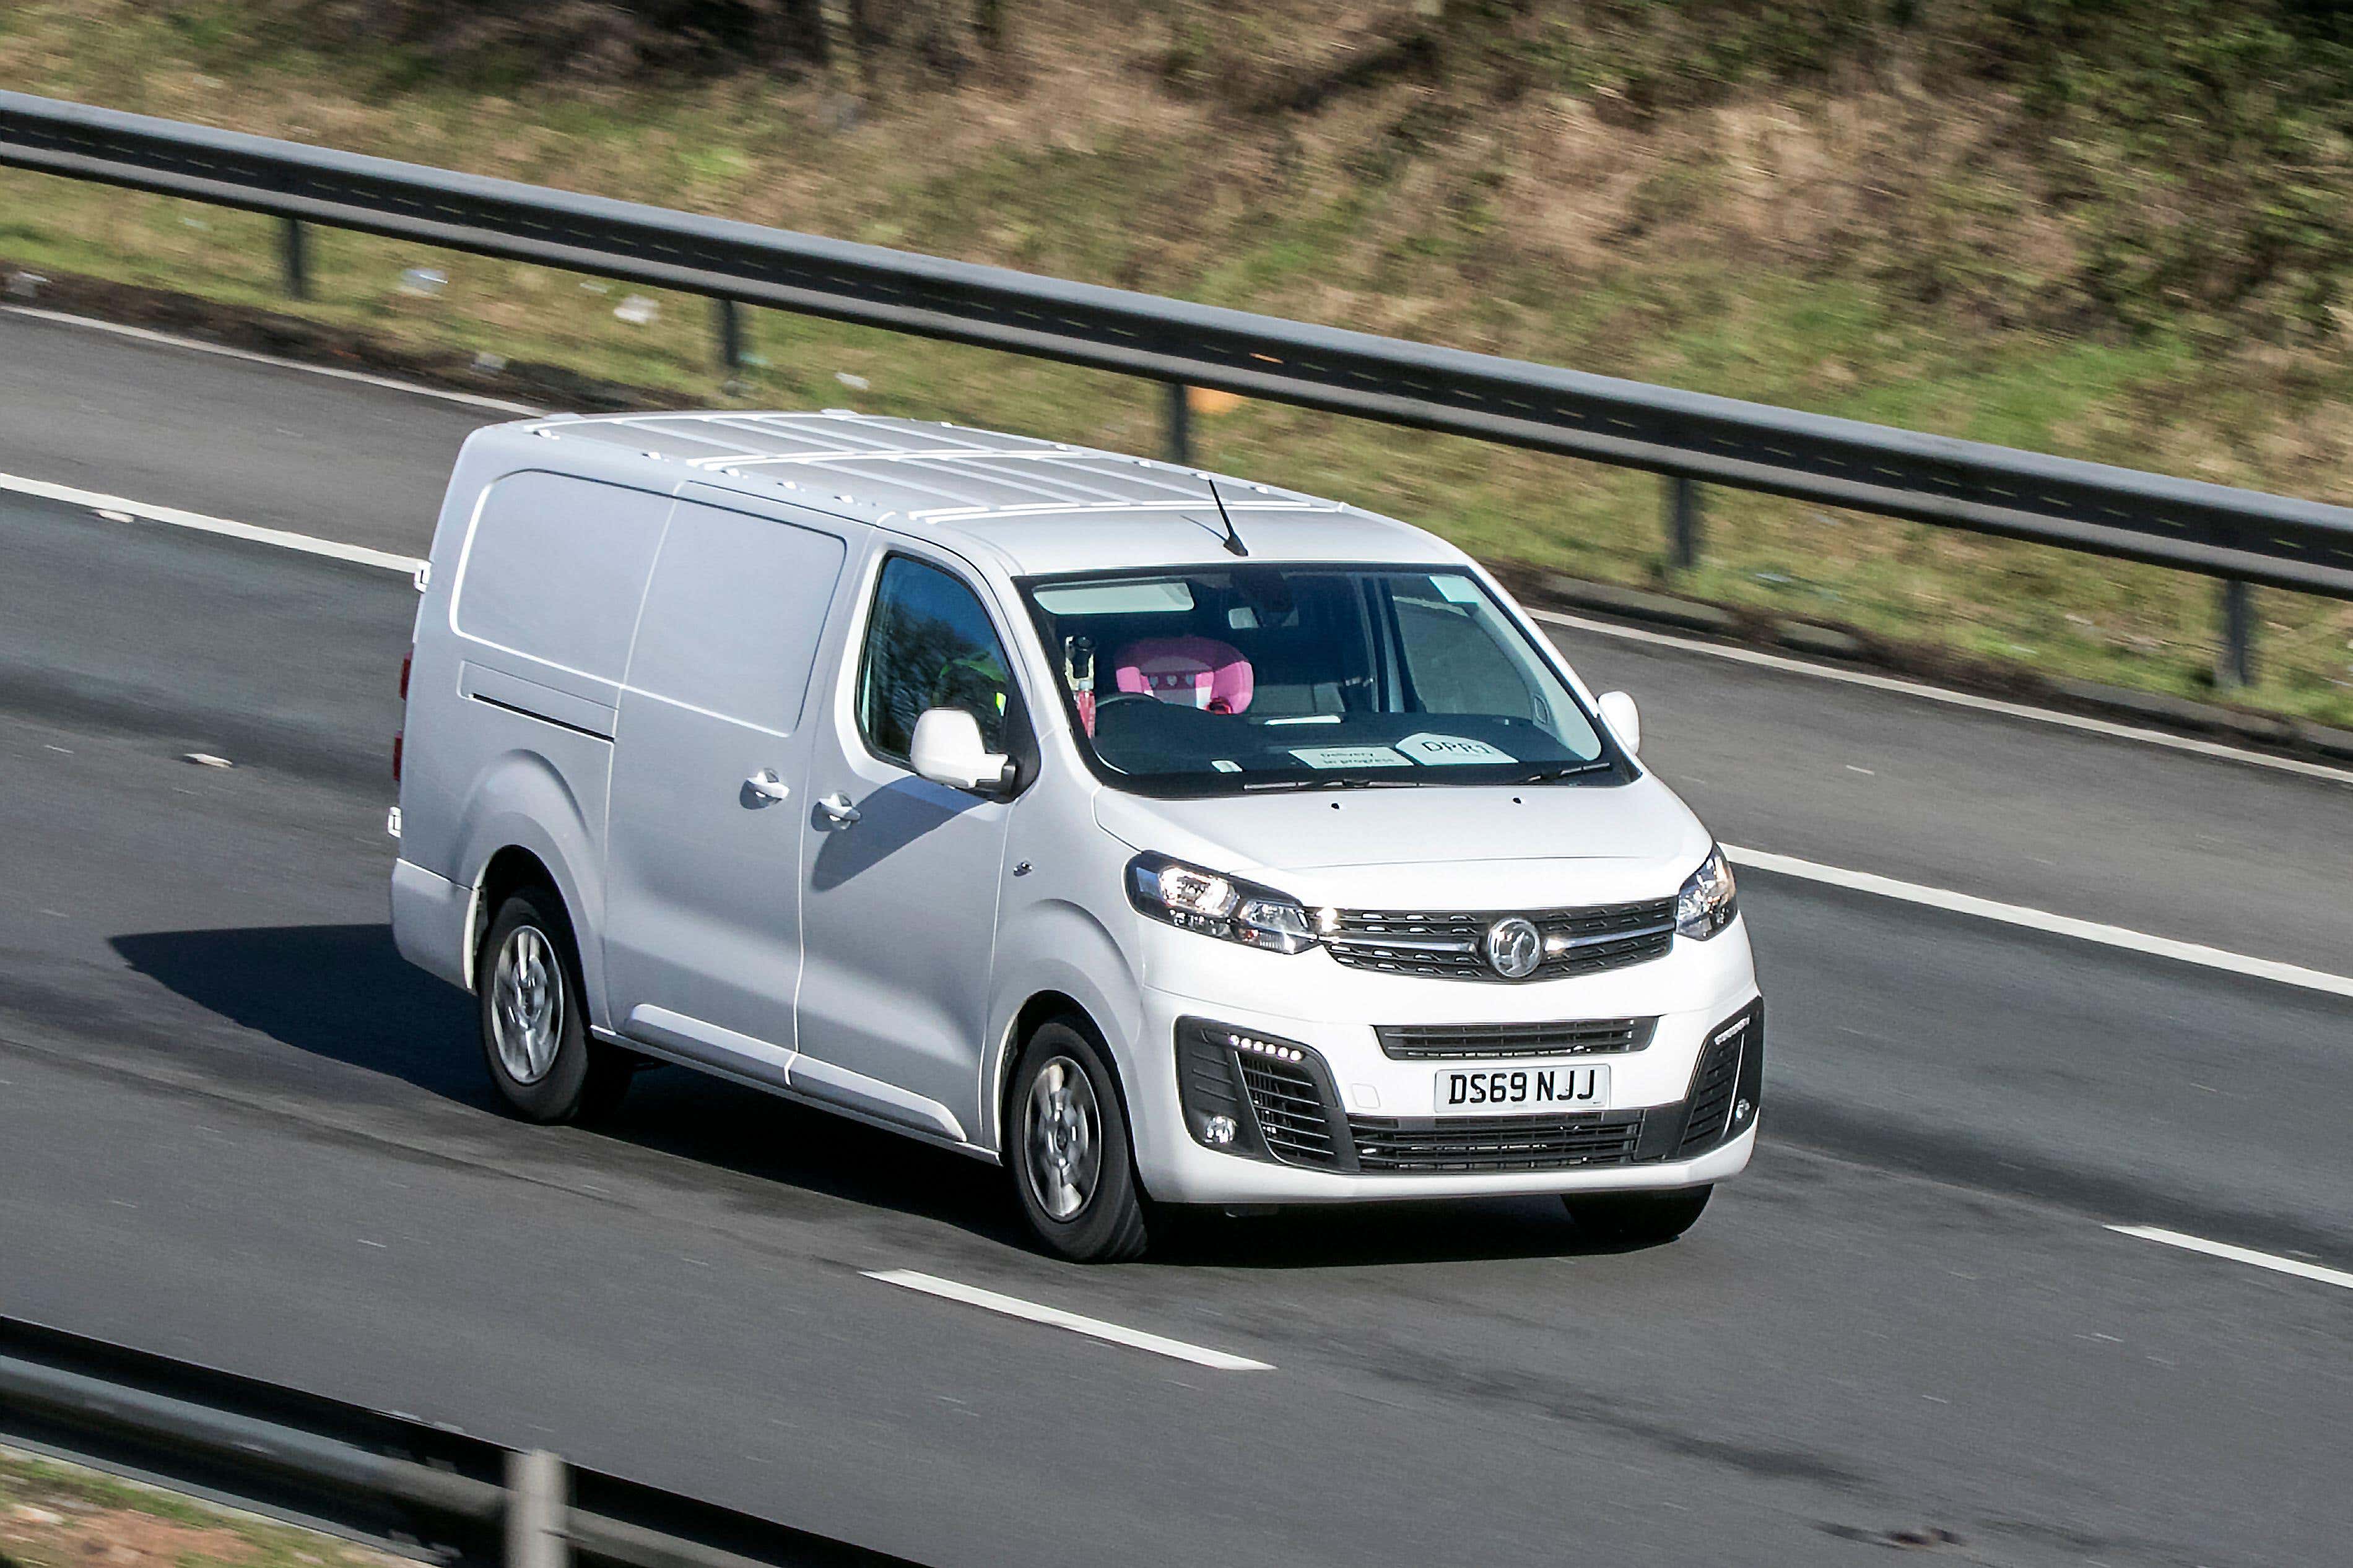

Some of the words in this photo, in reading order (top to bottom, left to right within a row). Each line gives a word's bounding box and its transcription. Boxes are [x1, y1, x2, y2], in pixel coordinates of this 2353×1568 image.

[1422, 741, 1495, 754] DPR1
[1449, 1073, 1527, 1104] DS69
[1536, 1070, 1594, 1101] NJJ
